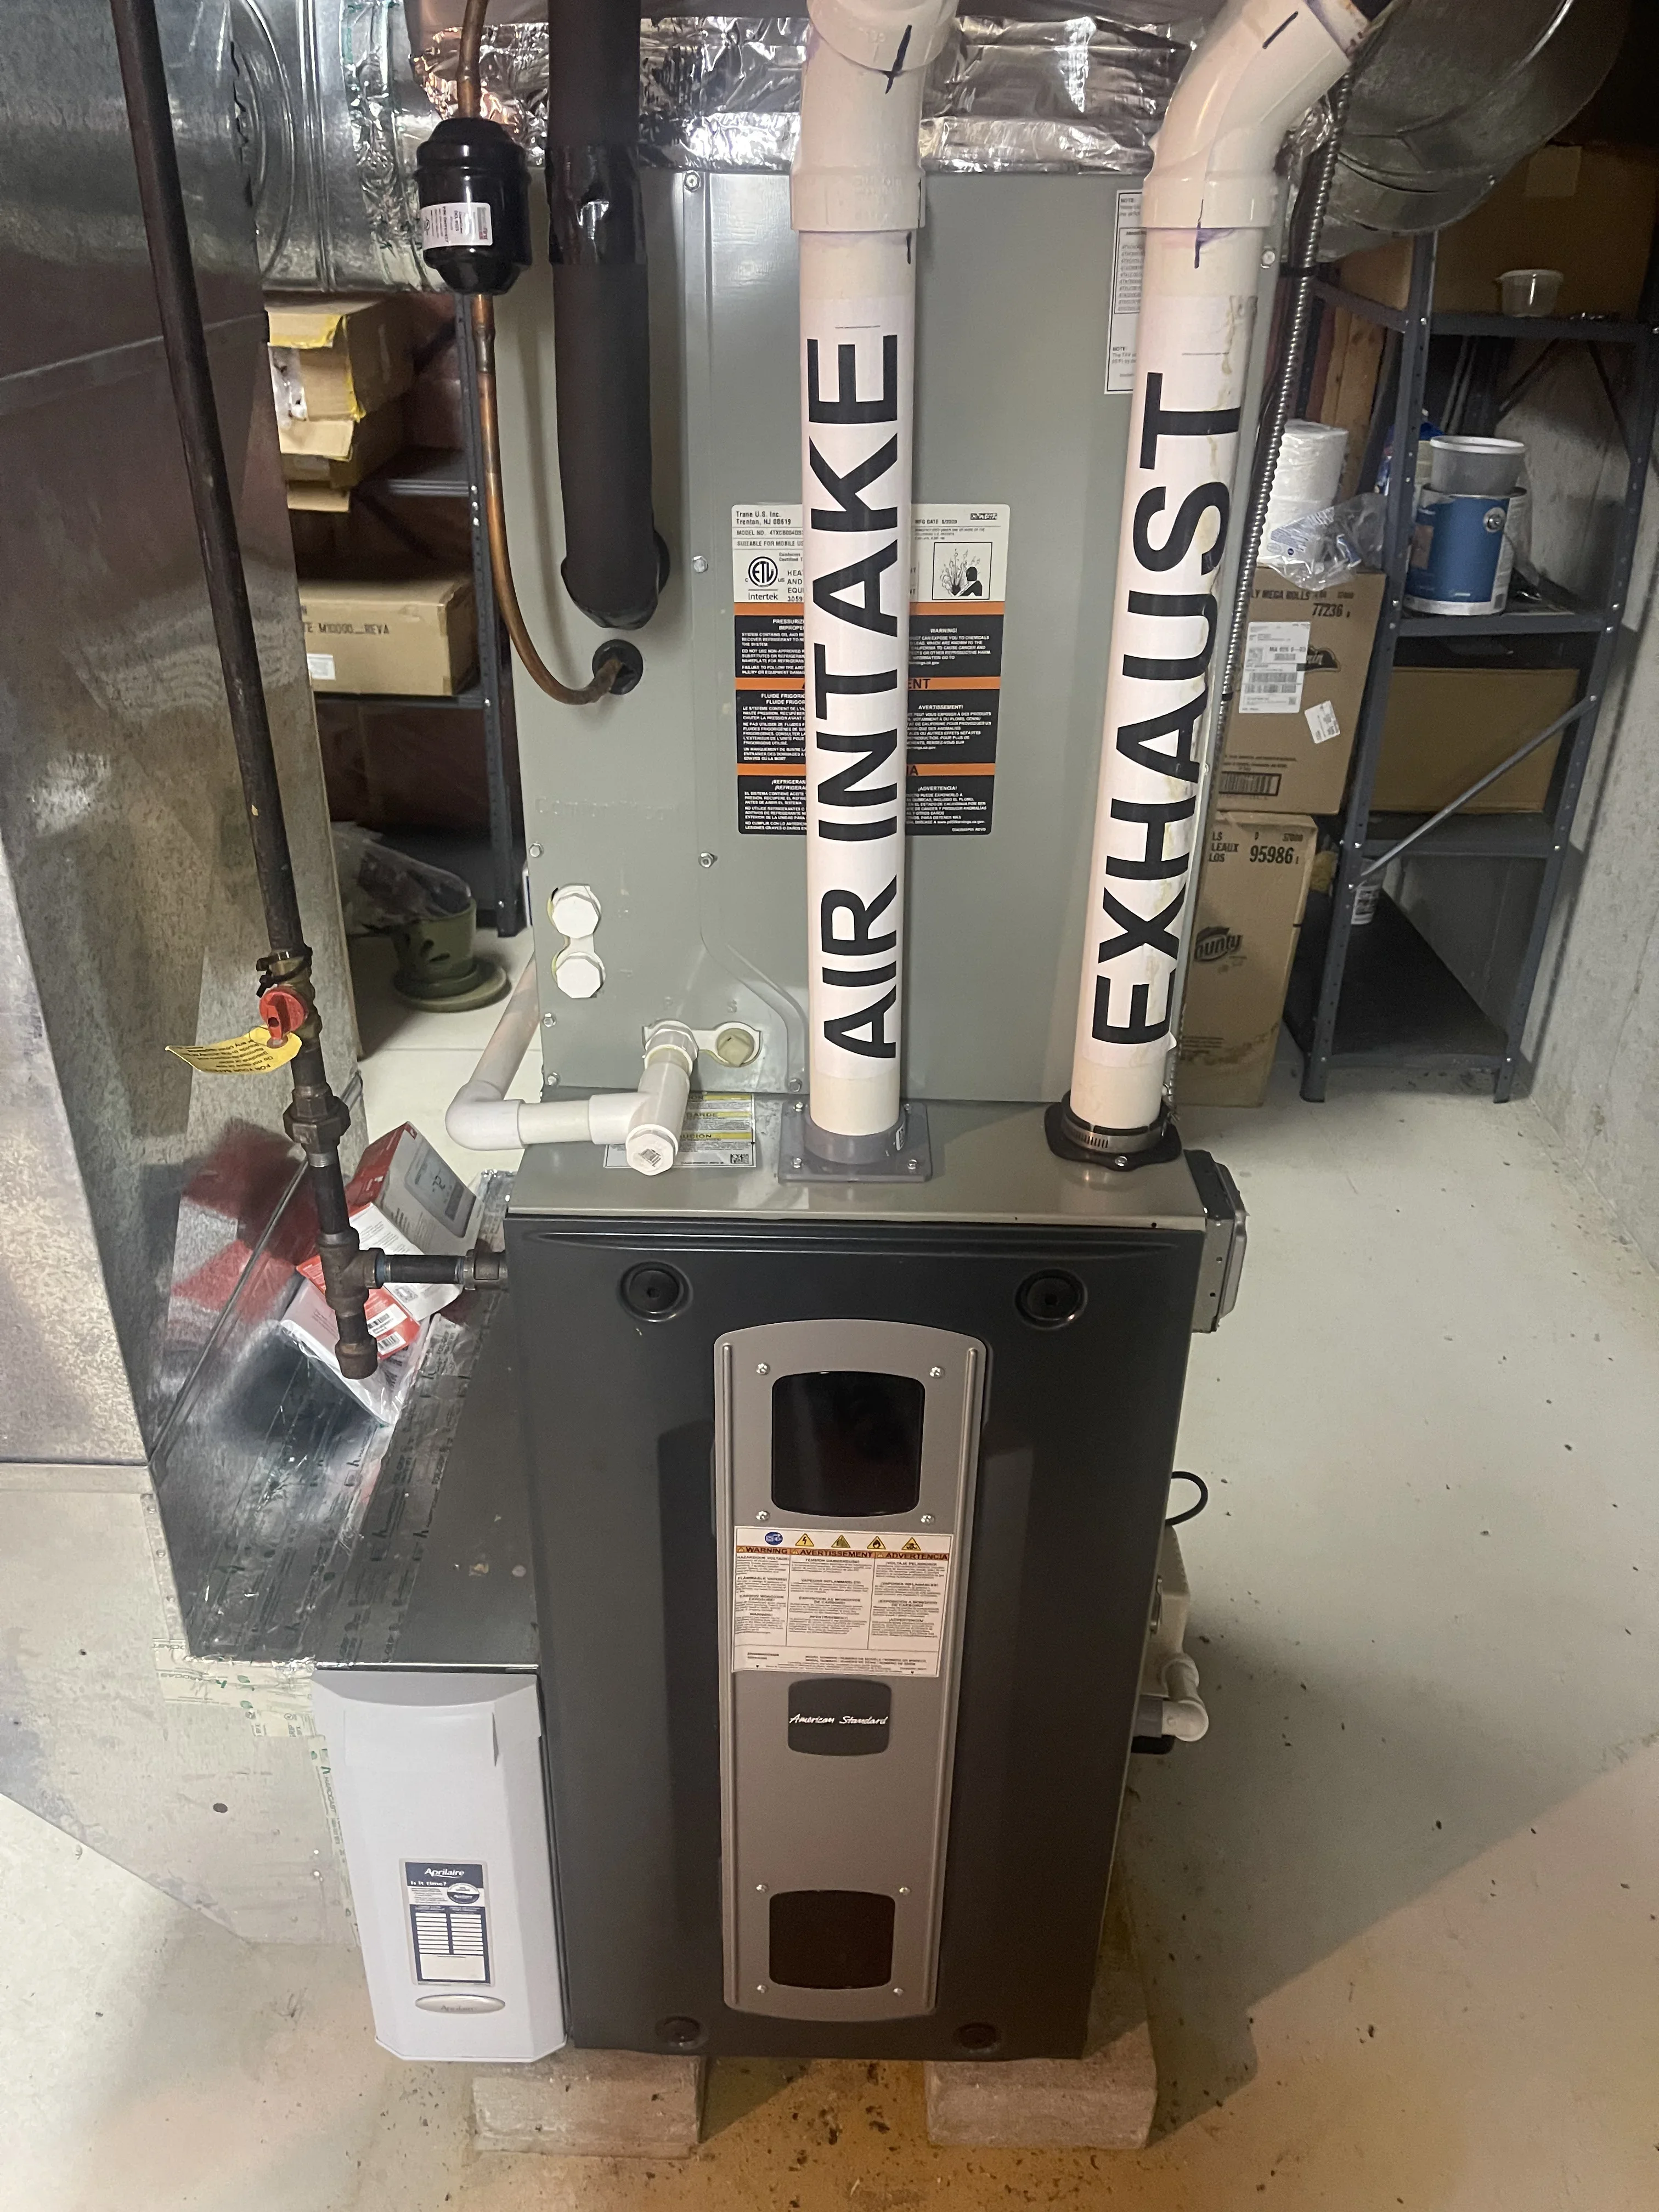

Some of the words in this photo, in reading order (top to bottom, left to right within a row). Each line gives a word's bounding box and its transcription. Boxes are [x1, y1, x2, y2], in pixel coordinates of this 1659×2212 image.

[807, 335, 898, 842] INTAKE
[1262, 590, 1283, 599] MEGA
[1286, 590, 1310, 600] ROLLS
[748, 592, 778, 601] Intertek
[1312, 602, 1344, 617] 77236
[1091, 372, 1242, 1045] EXHAUST
[1250, 845, 1294, 864] 95986
[821, 874, 897, 1059] AIR
[746, 1547, 788, 1555] WARNING
[800, 1549, 872, 1558] AVERTISSEMENT
[788, 1713, 835, 1725] American
[839, 1716, 889, 1725] Standard
[425, 1868, 465, 1877] Aprilaire
